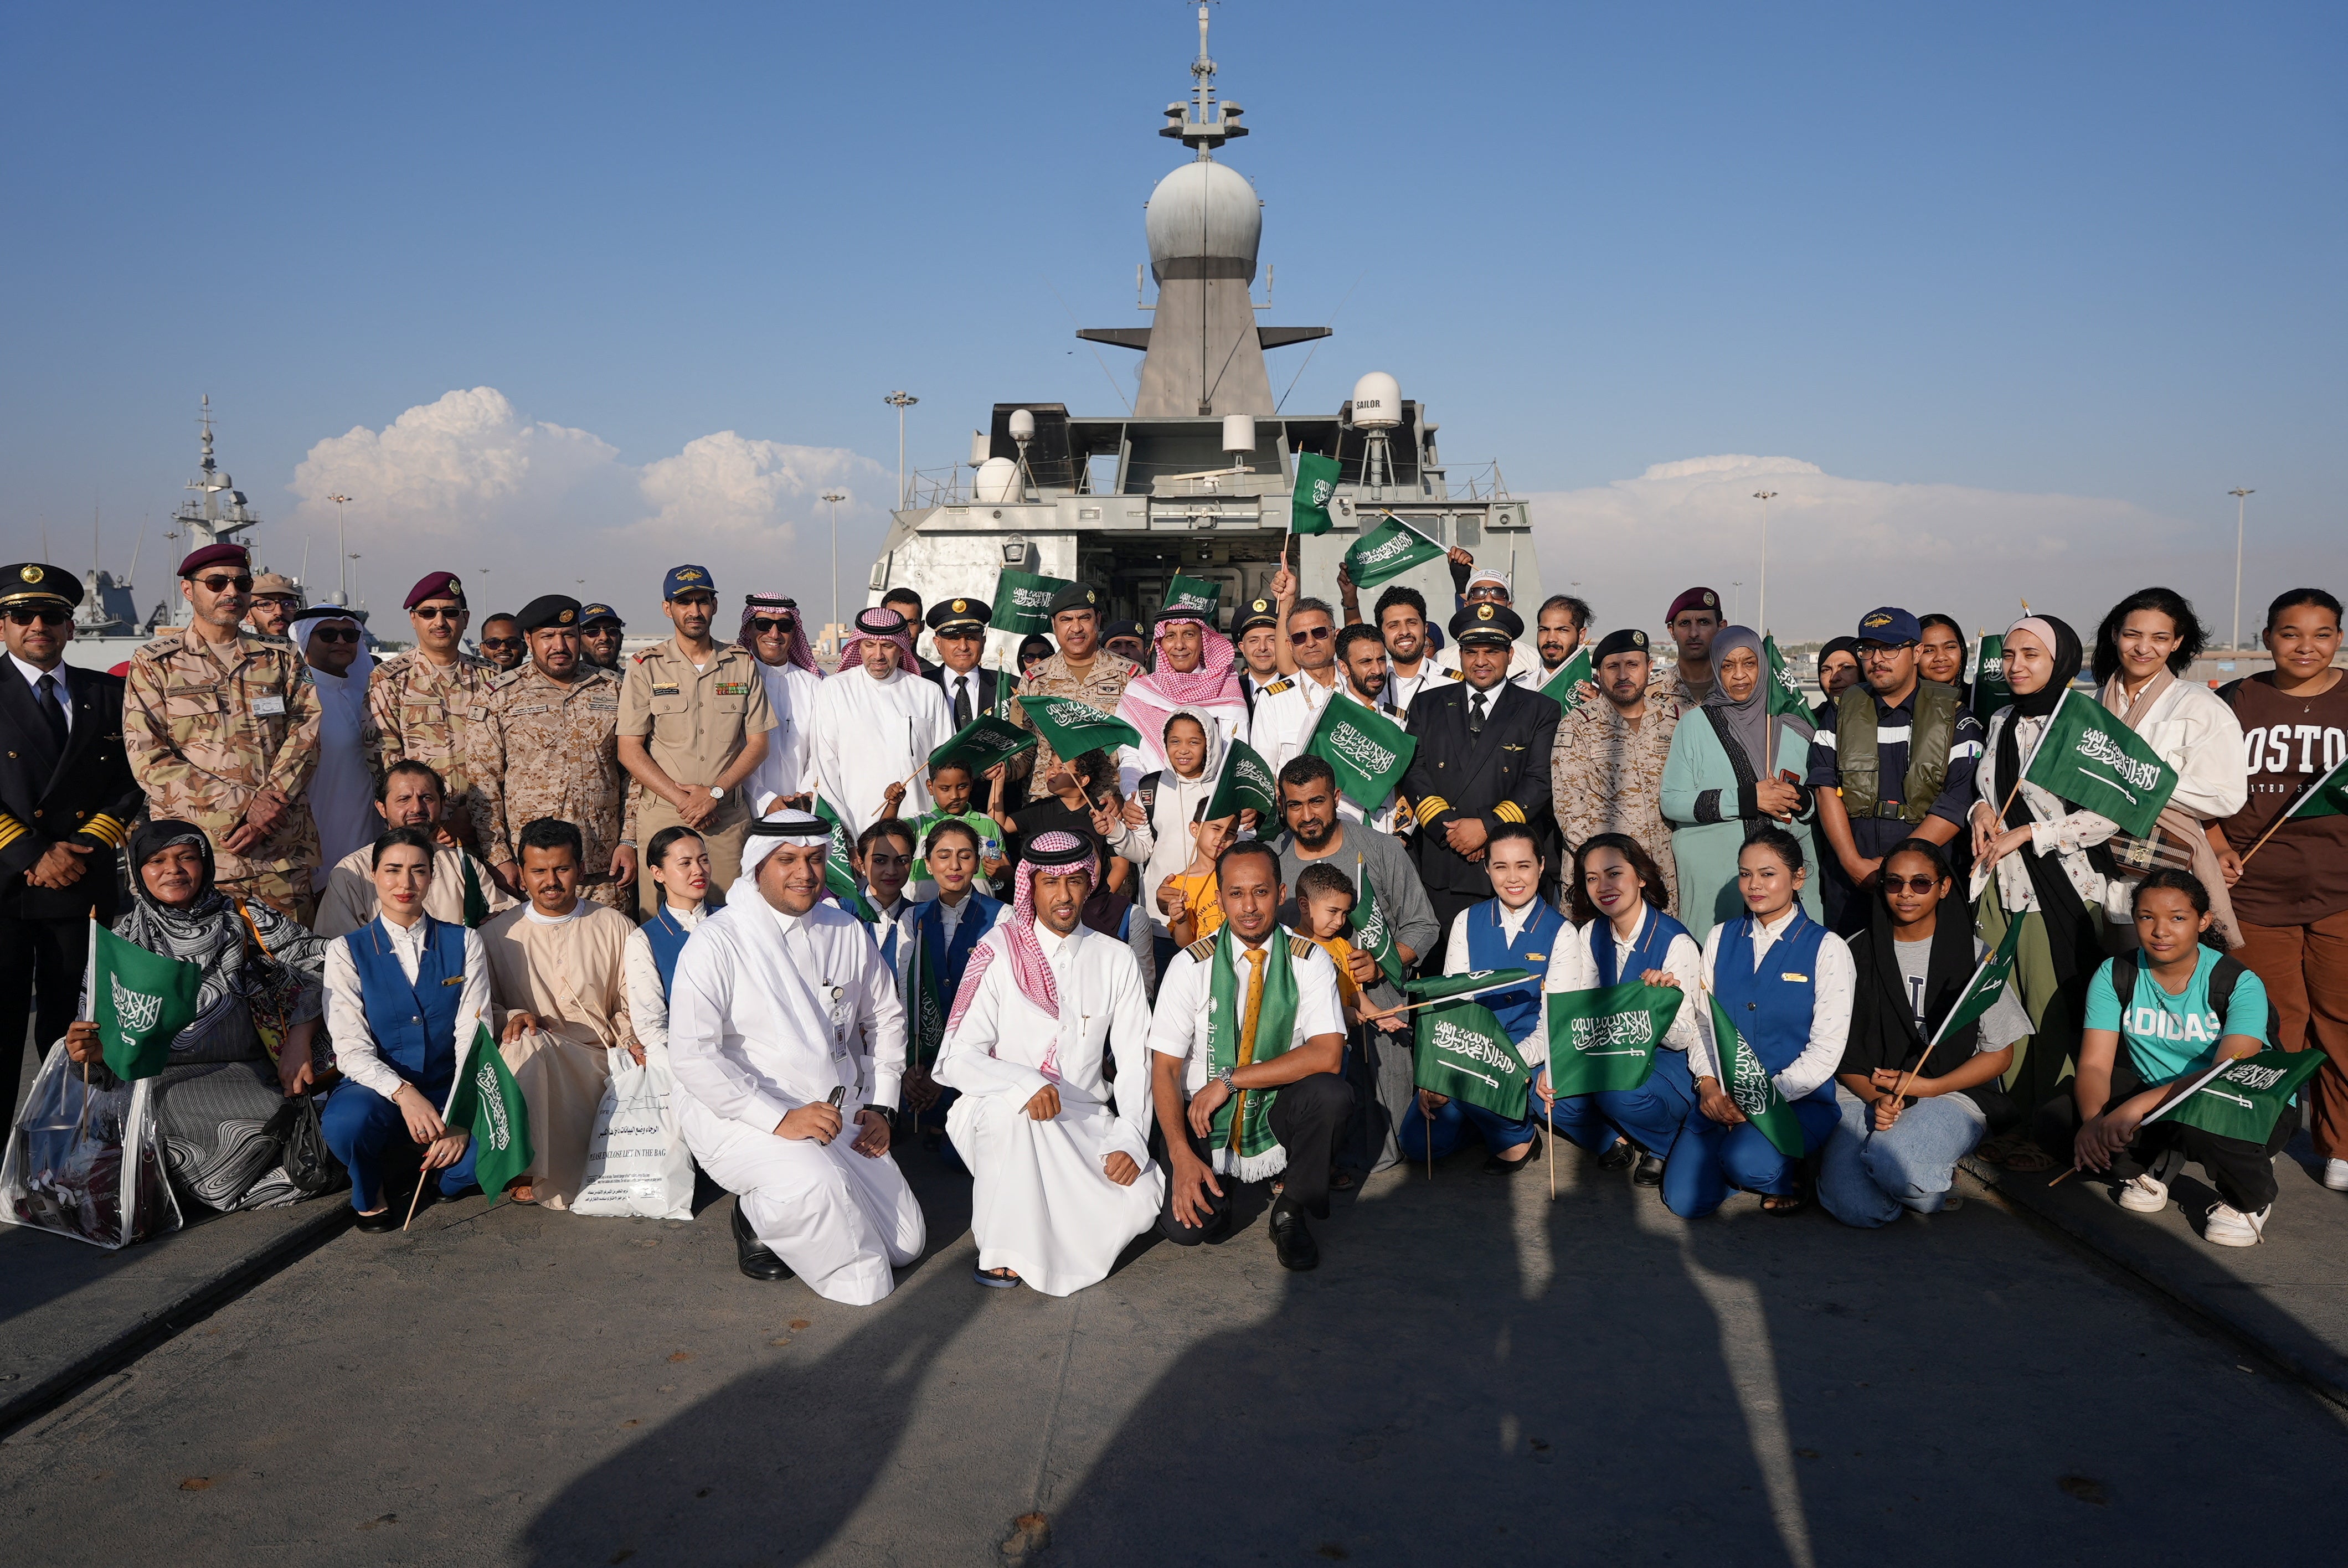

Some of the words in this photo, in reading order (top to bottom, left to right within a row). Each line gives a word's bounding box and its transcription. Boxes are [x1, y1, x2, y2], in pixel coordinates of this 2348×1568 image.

[2244, 724, 2348, 776] OSTO
[2251, 783, 2285, 793] ITED
[1197, 906, 1208, 917] THE
[1207, 899, 1218, 908] LIO
[2123, 1007, 2221, 1042] ADIDAS
[1208, 1022, 1218, 1081] لسعودية
[654, 1148, 666, 1157] BAG
[1356, 1507, 1380, 1517] SAILOR
